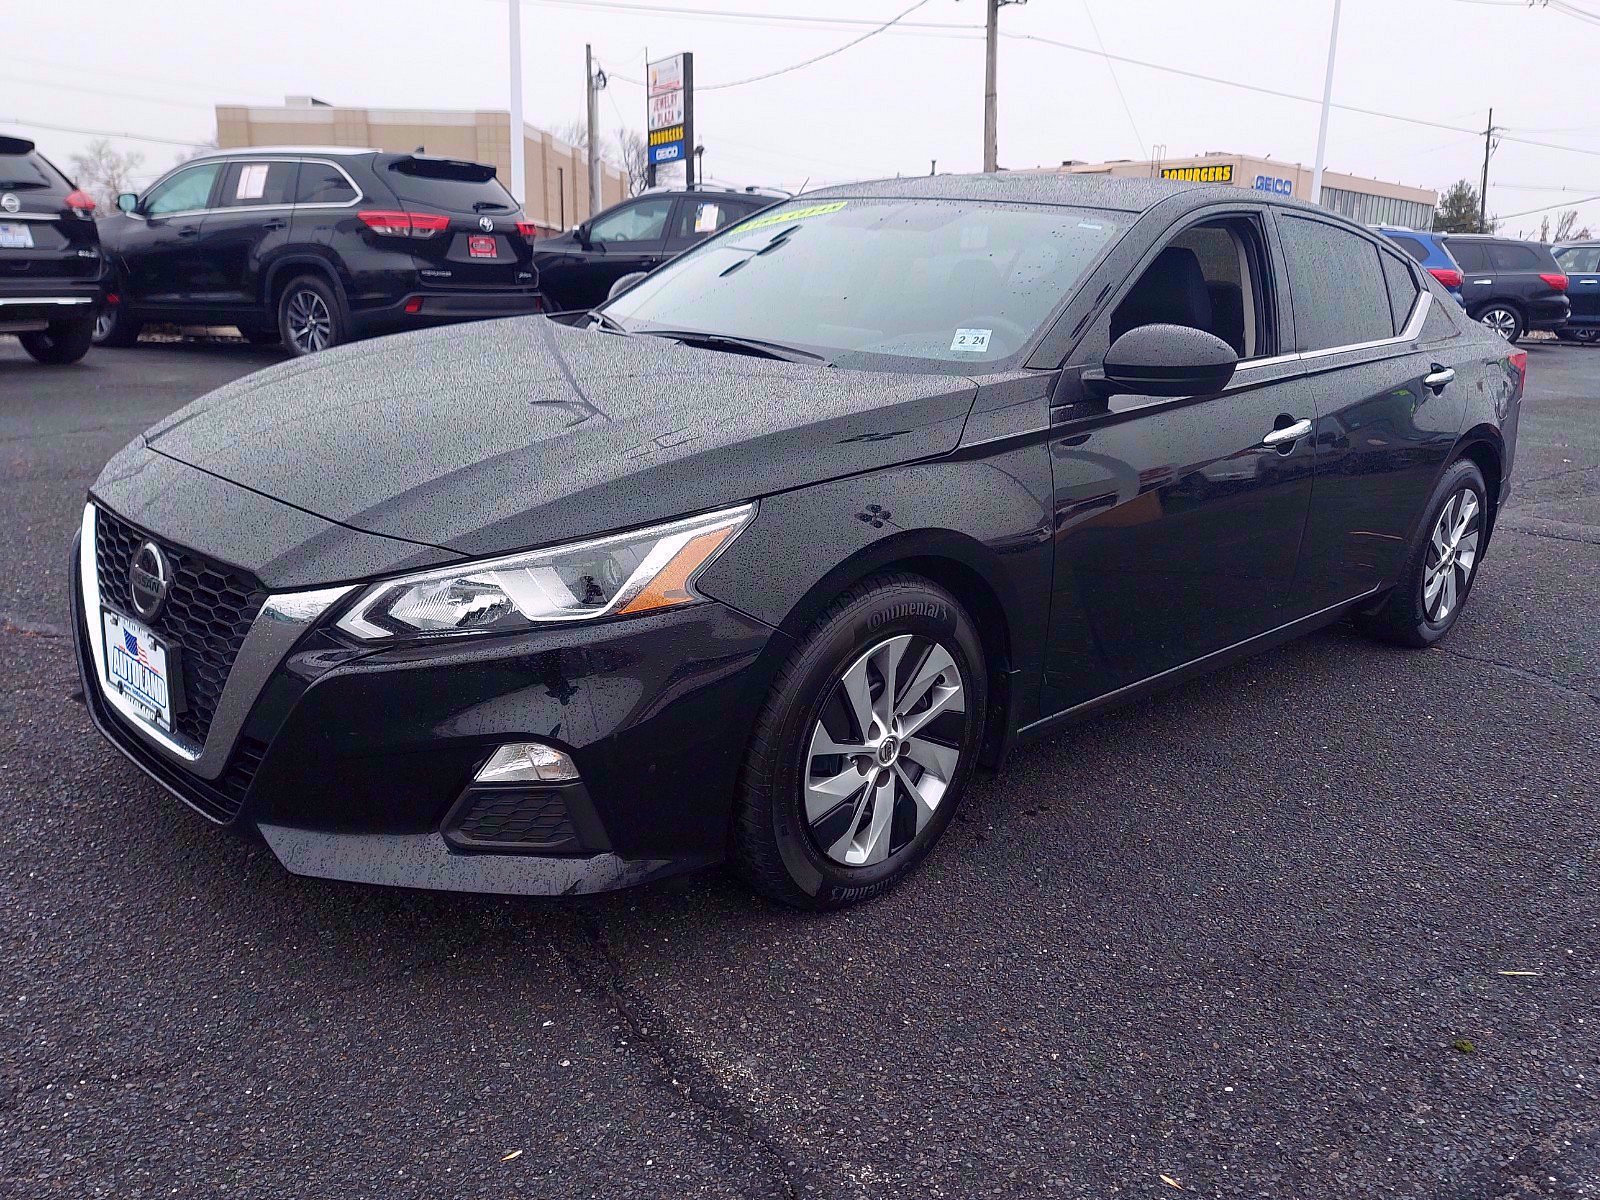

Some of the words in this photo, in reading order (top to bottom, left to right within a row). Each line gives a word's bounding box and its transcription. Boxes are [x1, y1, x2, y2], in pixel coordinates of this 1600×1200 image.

[654, 94, 677, 112] JEWELRY
[657, 110, 675, 126] PLAZA
[656, 145, 678, 161] GEICO
[1255, 175, 1292, 196] GEICO
[958, 335, 966, 345] 2
[972, 336, 985, 345] 24
[866, 602, 940, 632] Continental
[113, 647, 166, 708] AUTOLAND
